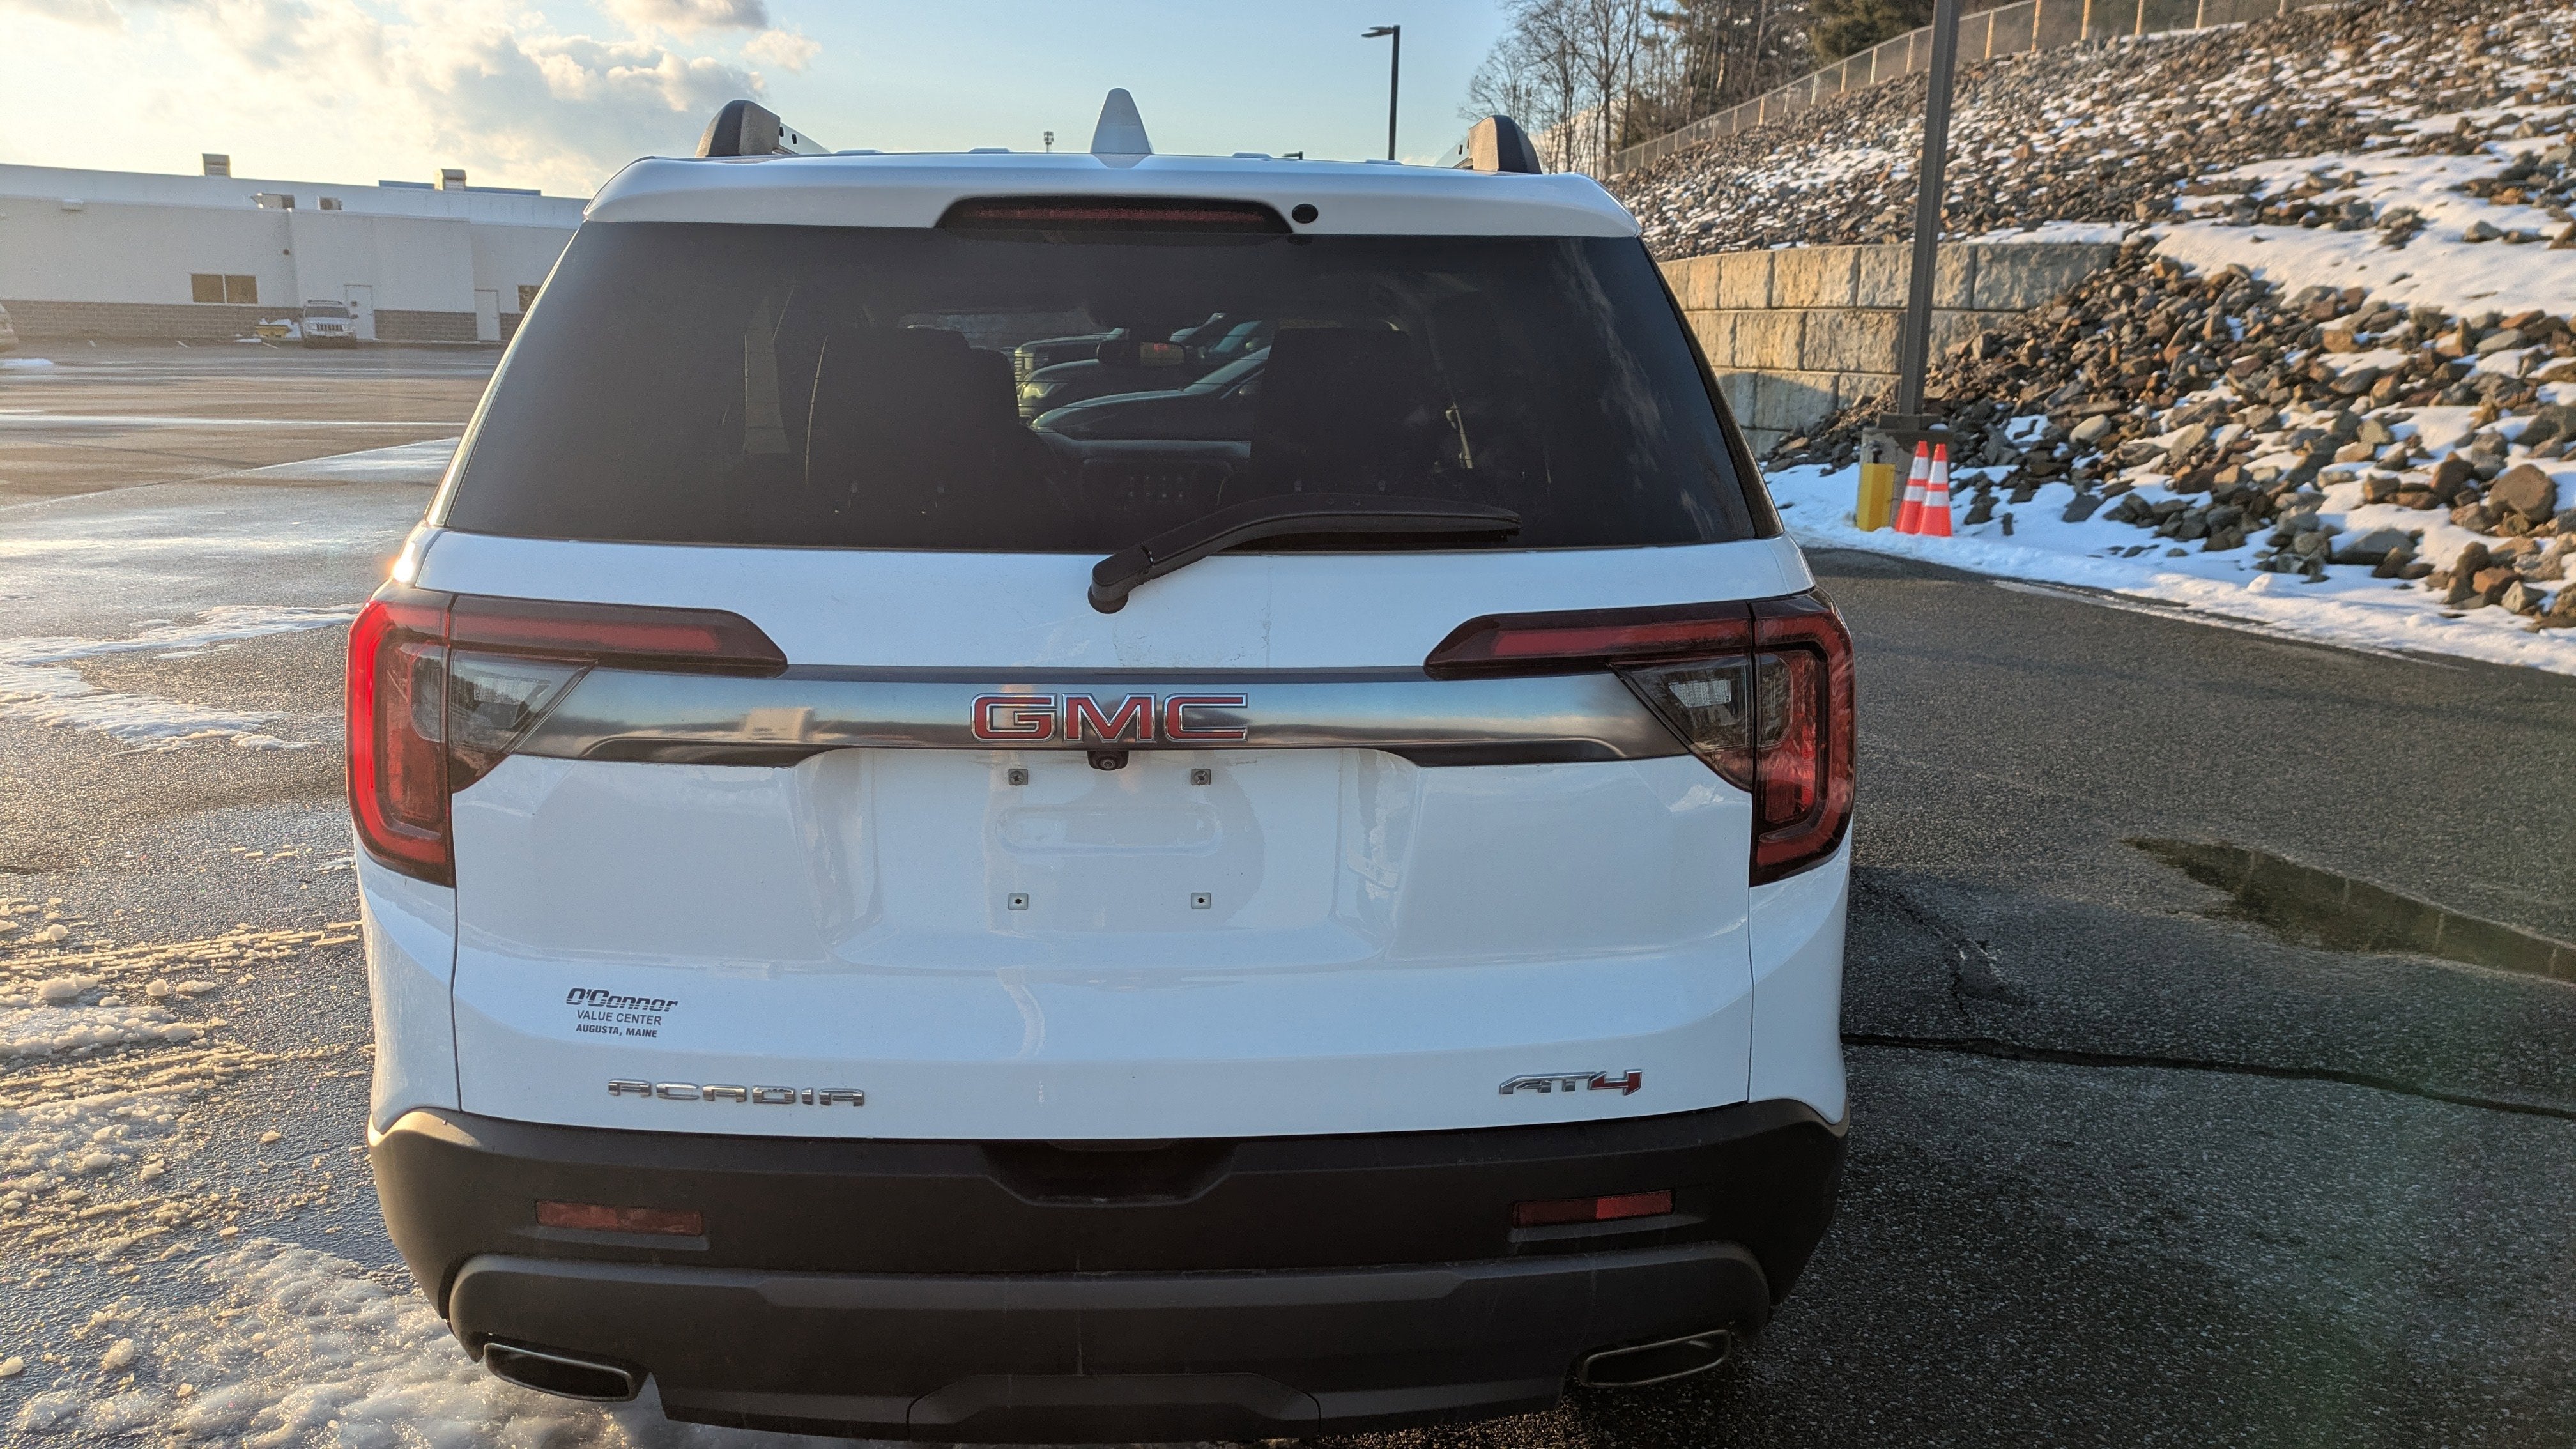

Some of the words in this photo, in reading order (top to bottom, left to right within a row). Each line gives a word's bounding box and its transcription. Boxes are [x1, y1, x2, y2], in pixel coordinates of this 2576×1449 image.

[970, 693, 1249, 744] GMC
[566, 988, 678, 1012] O'Connor
[577, 1009, 613, 1022] VALUE
[616, 1013, 661, 1025] CENTER
[576, 1023, 622, 1036] AUGUSTA,
[625, 1027, 657, 1038] MAINE
[607, 1078, 865, 1107] ACADIA
[1499, 1068, 1642, 1096] AT4
